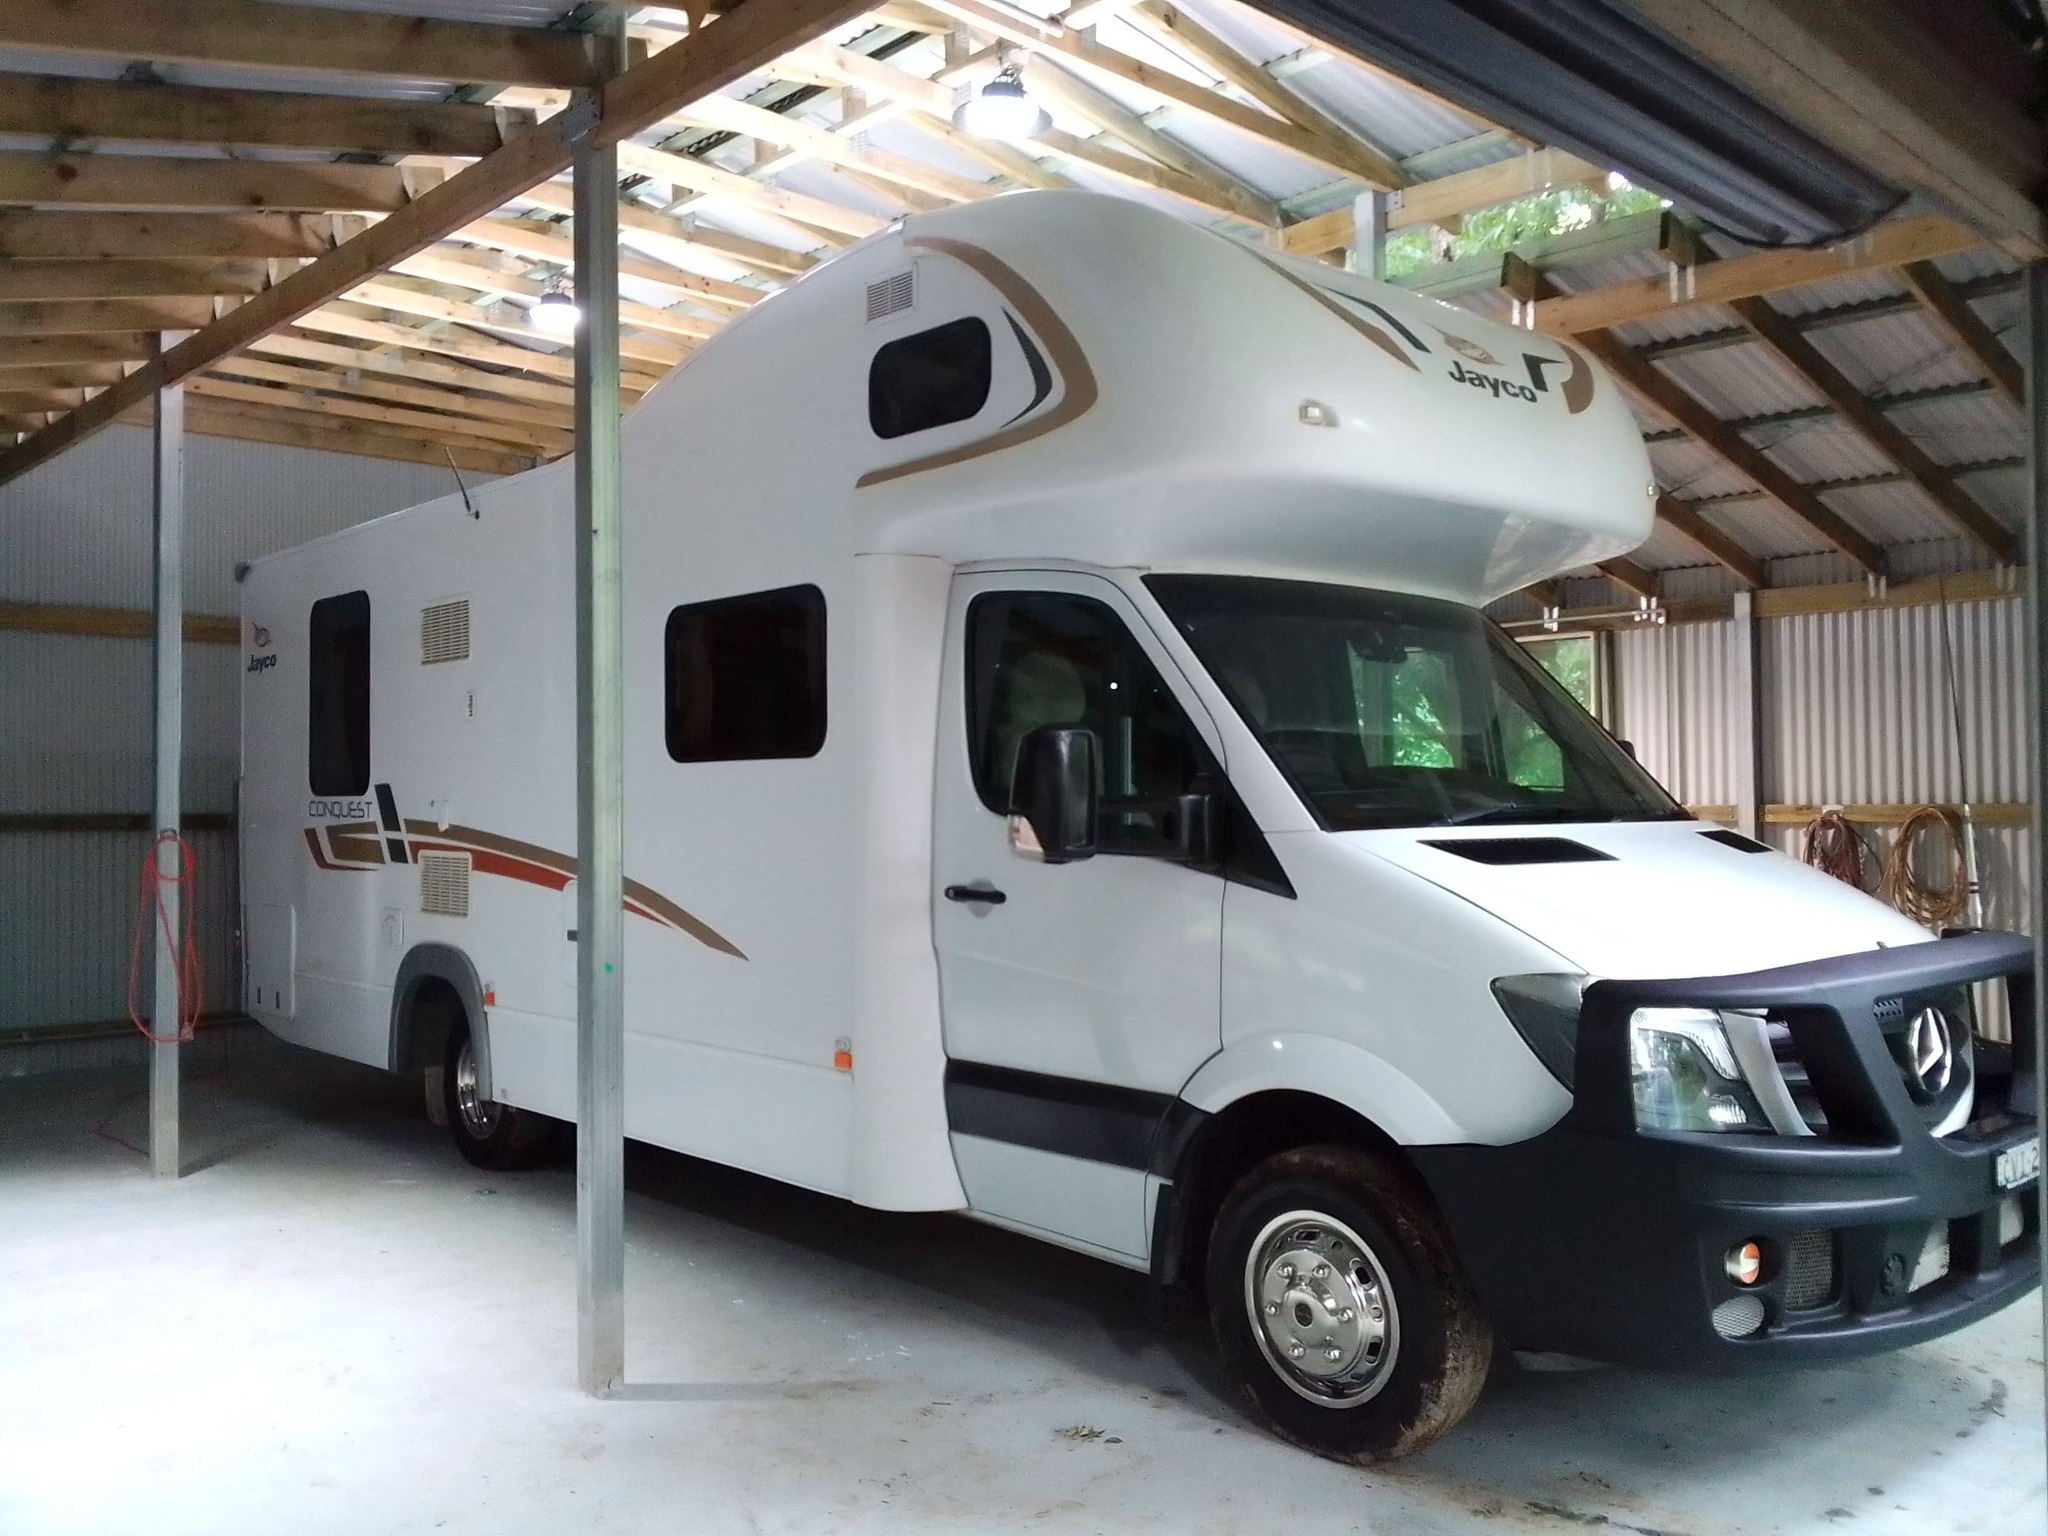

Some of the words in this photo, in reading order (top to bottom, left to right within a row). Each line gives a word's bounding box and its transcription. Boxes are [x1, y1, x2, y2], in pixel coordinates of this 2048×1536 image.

[1448, 360, 1537, 403] Jayco
[247, 654, 277, 674] Jayco
[309, 801, 373, 819] CONQUEST
